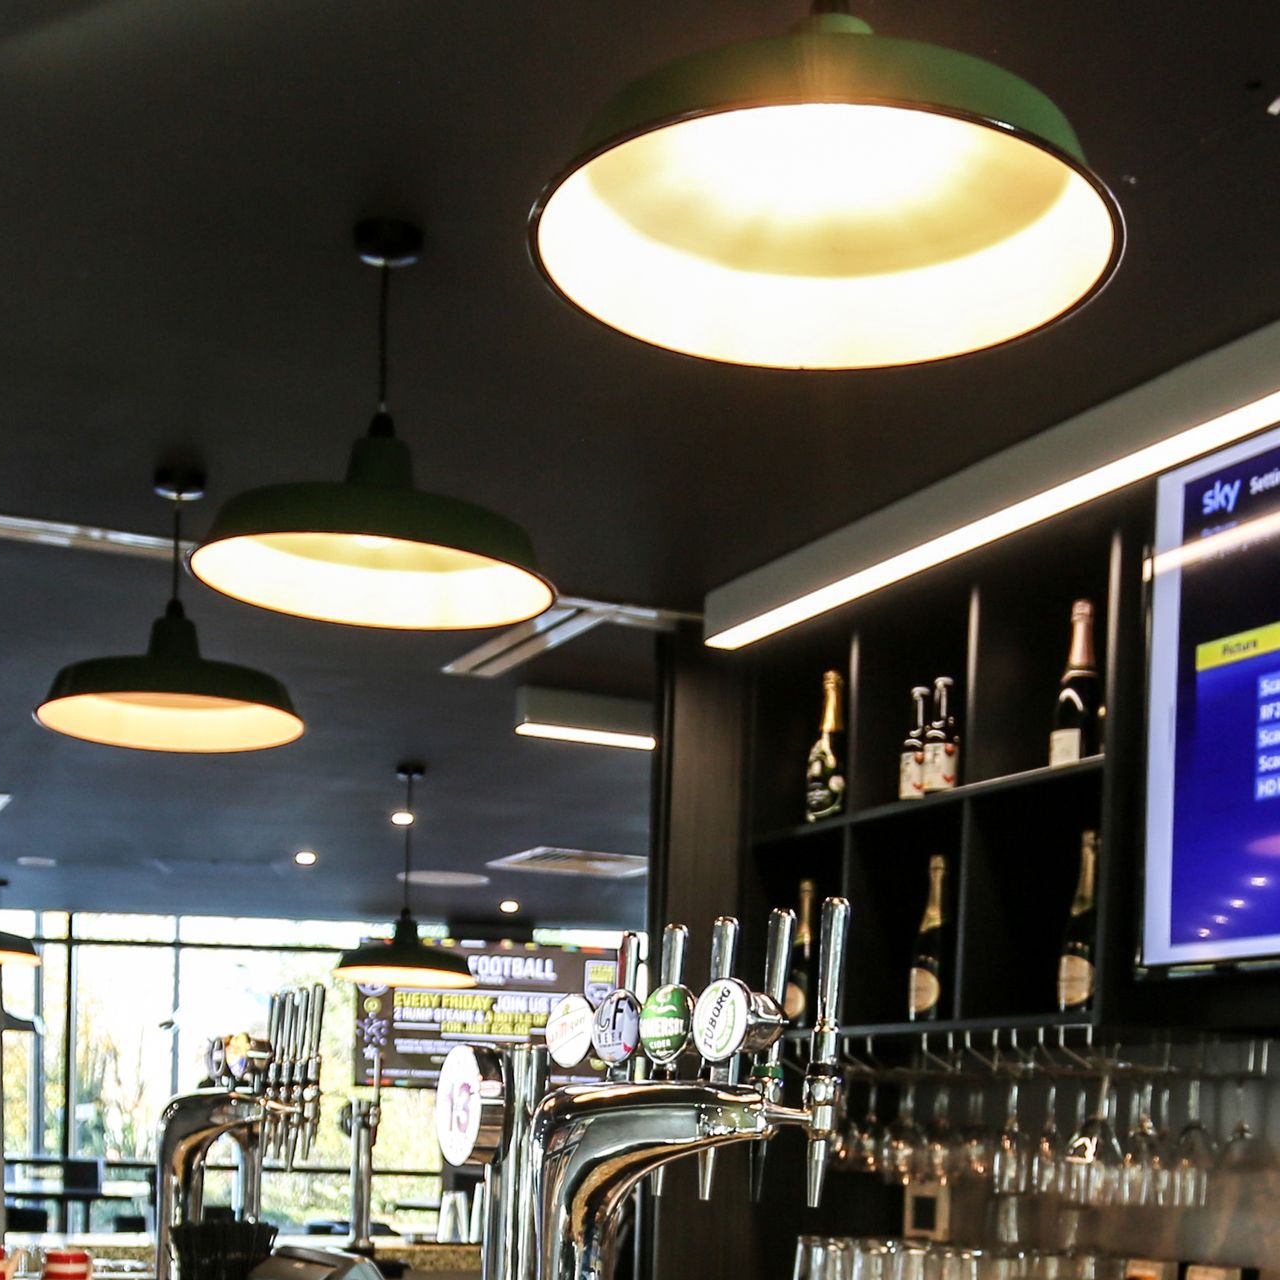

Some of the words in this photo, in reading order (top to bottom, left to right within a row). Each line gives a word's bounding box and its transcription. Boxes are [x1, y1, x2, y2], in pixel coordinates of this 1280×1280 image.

[1202, 479, 1241, 515] sky
[1257, 780, 1277, 797] HD
[468, 955, 558, 982] FOOTBALL
[394, 992, 440, 1008] EVERY
[441, 993, 493, 1011] FRIDAY
[492, 995, 528, 1013] JOIN
[433, 1009, 474, 1023] STEAKS
[702, 986, 731, 1049] TUBORG
[462, 1022, 488, 1034] JUST
[649, 1039, 671, 1050] CIDER
